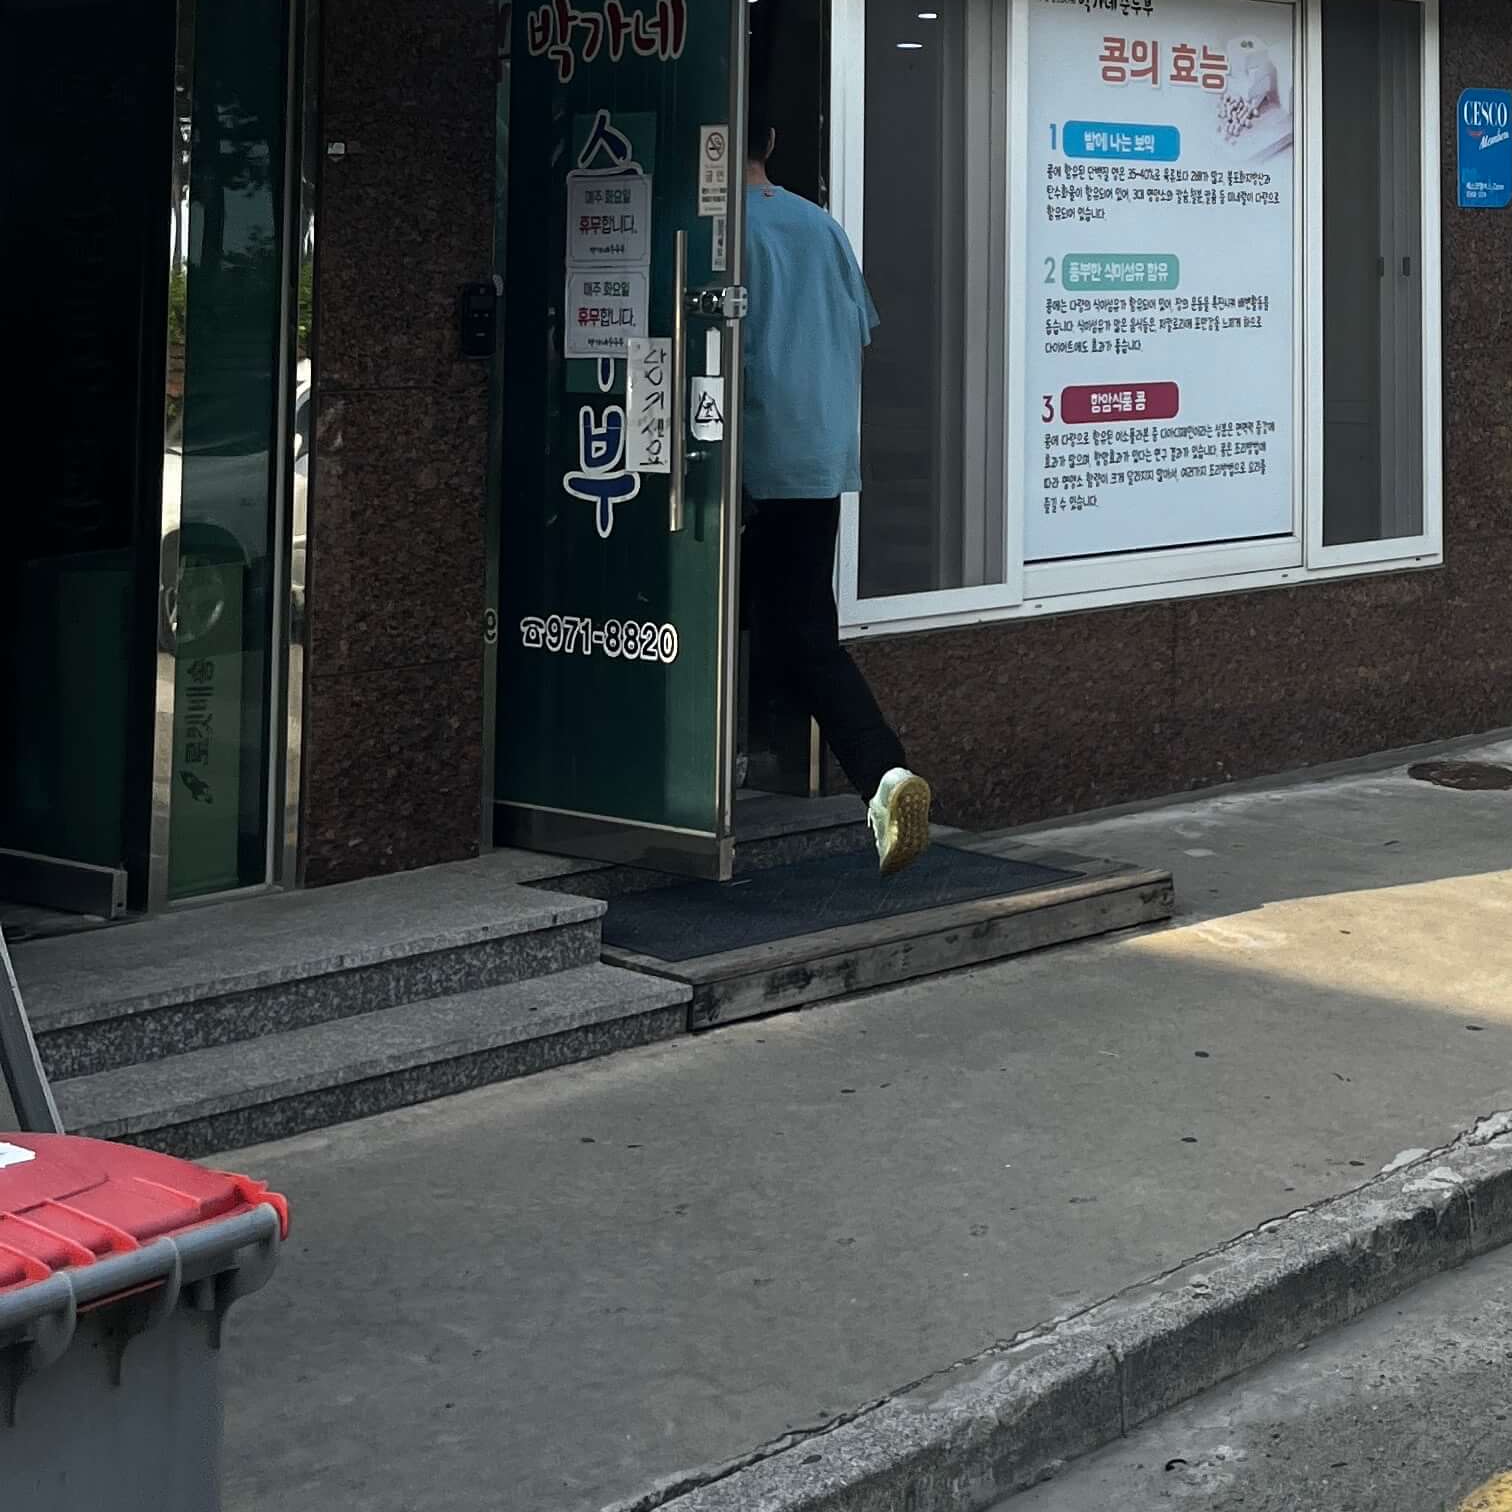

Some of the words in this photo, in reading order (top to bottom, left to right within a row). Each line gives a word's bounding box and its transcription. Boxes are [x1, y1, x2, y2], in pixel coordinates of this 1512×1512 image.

[1098, 36, 1159, 86] 콩의
[1169, 42, 1230, 91] 효능
[1463, 100, 1508, 127] CESCO
[1110, 133, 1132, 152] 나는
[1044, 256, 1056, 284] 2
[603, 281, 630, 297] 화요일
[577, 307, 636, 327] 휴무합니다.
[1041, 395, 1054, 423] 3
[1090, 391, 1132, 414] 항암식품
[1135, 390, 1146, 411] 콩
[544, 615, 679, 663] 971-8820
